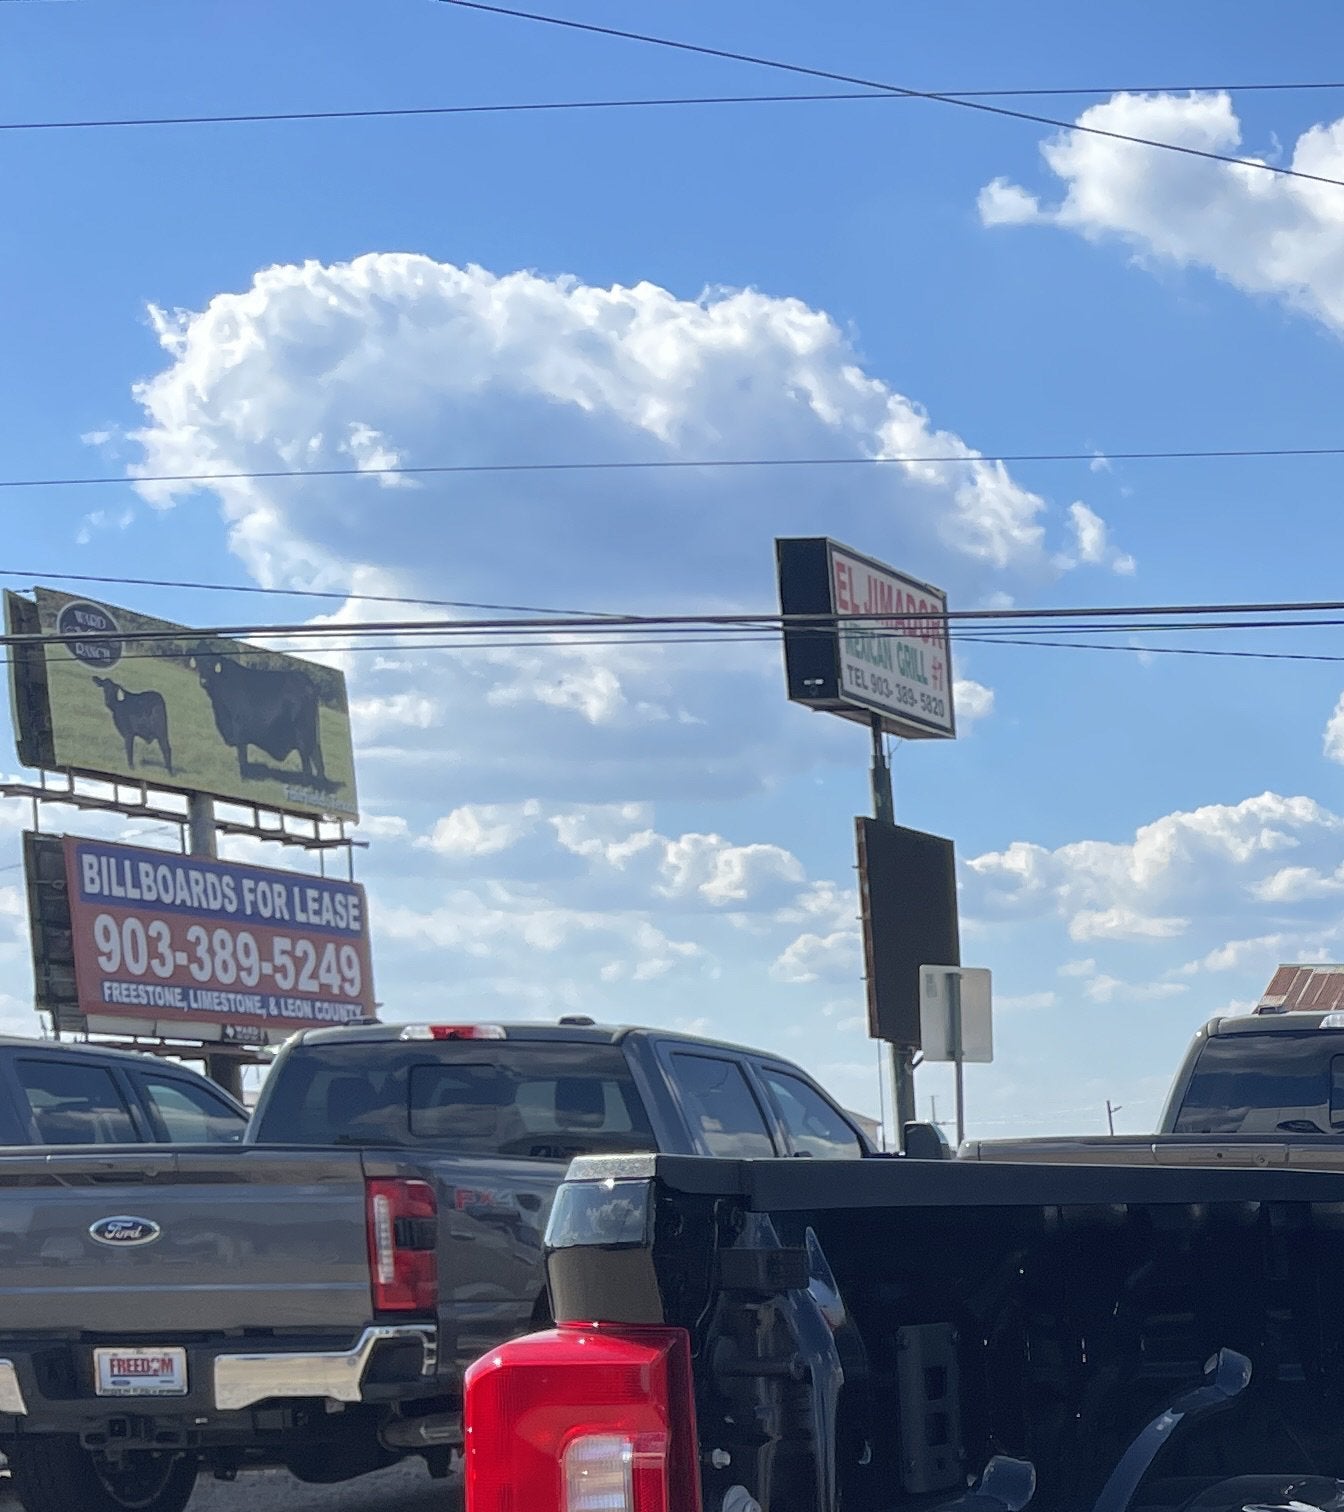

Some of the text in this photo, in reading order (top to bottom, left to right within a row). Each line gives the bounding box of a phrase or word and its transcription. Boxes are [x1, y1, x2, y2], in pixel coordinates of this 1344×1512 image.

[836, 561, 943, 650] EL JIMADOR
[847, 663, 868, 690] TEL
[896, 641, 928, 685] GRILL
[82, 853, 361, 931] BILLBOARDS FOR LEASE
[93, 913, 361, 998] 903-389-5249
[103, 981, 363, 1022] FREESTONE, LIMESTONE, & LEON COUNTY
[104, 1221, 143, 1239] Ford
